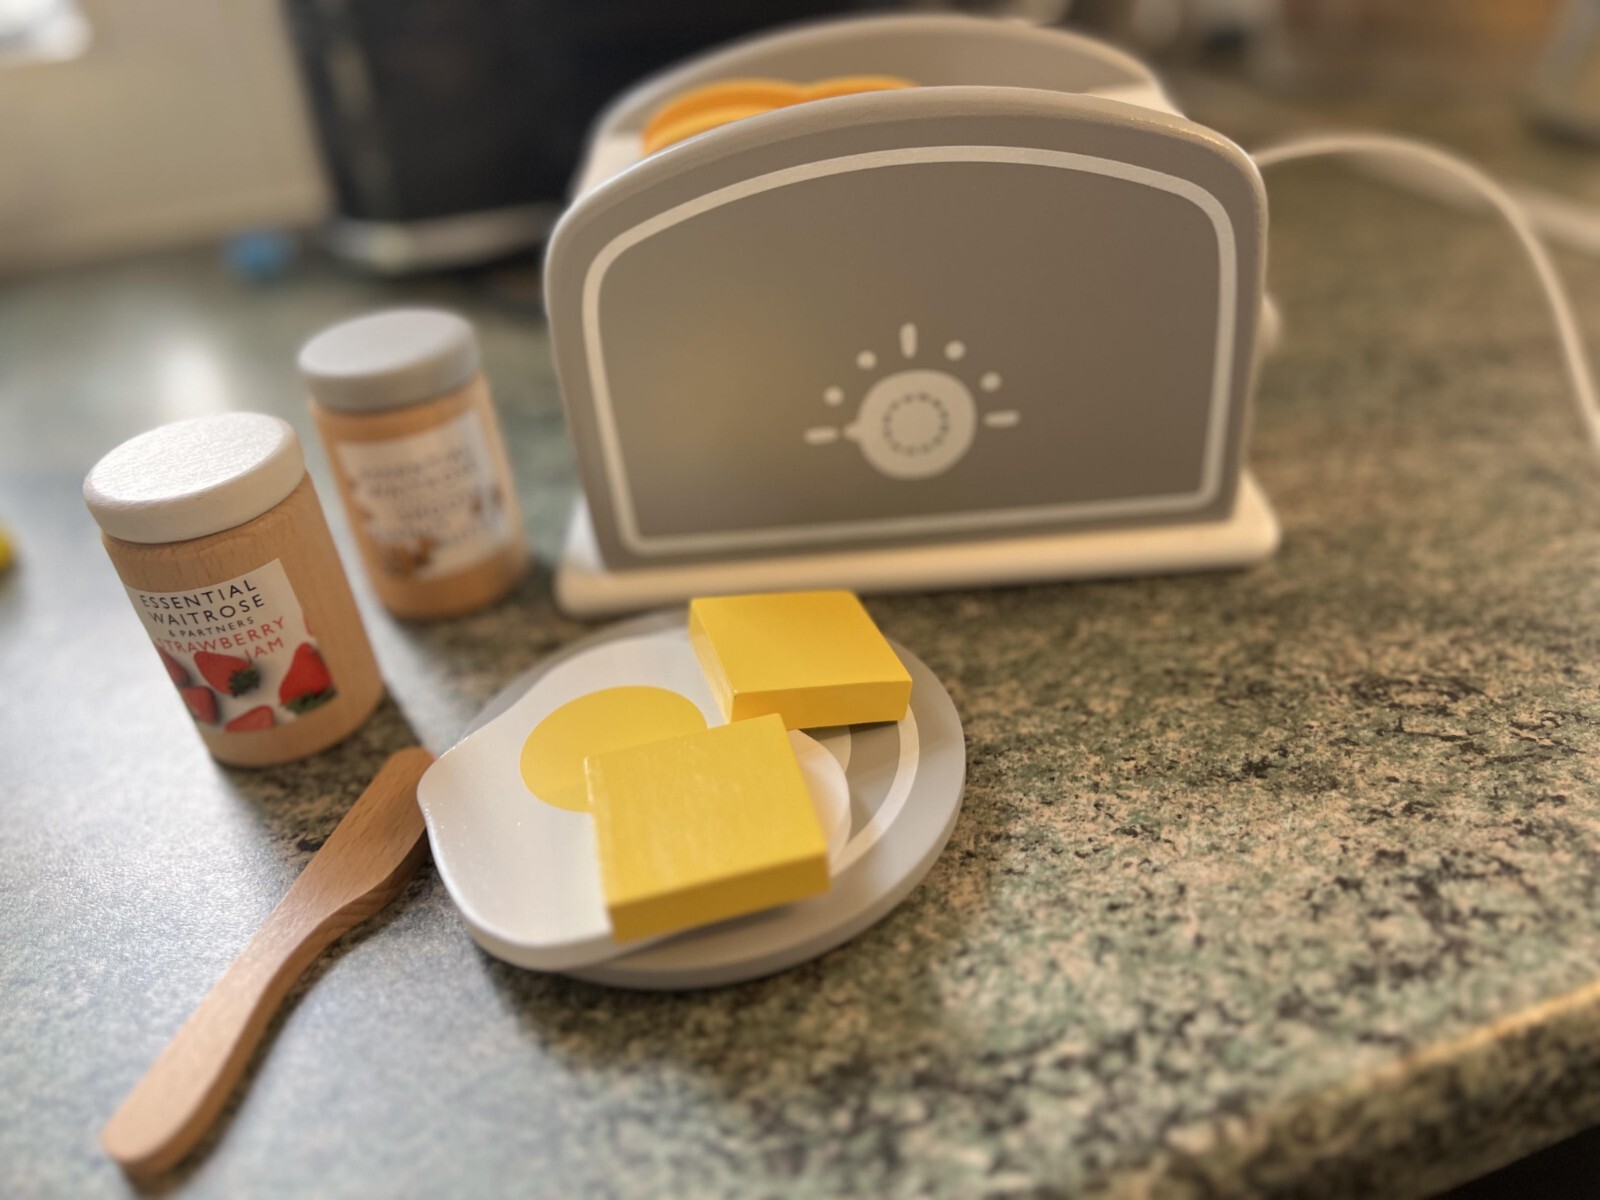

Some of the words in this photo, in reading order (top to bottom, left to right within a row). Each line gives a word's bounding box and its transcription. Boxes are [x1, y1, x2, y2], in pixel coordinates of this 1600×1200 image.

[139, 579, 257, 610] ESSENTIAL
[147, 593, 265, 626] WAITROSE
[179, 616, 255, 638] PARTNERS
[244, 637, 285, 660] JAM
